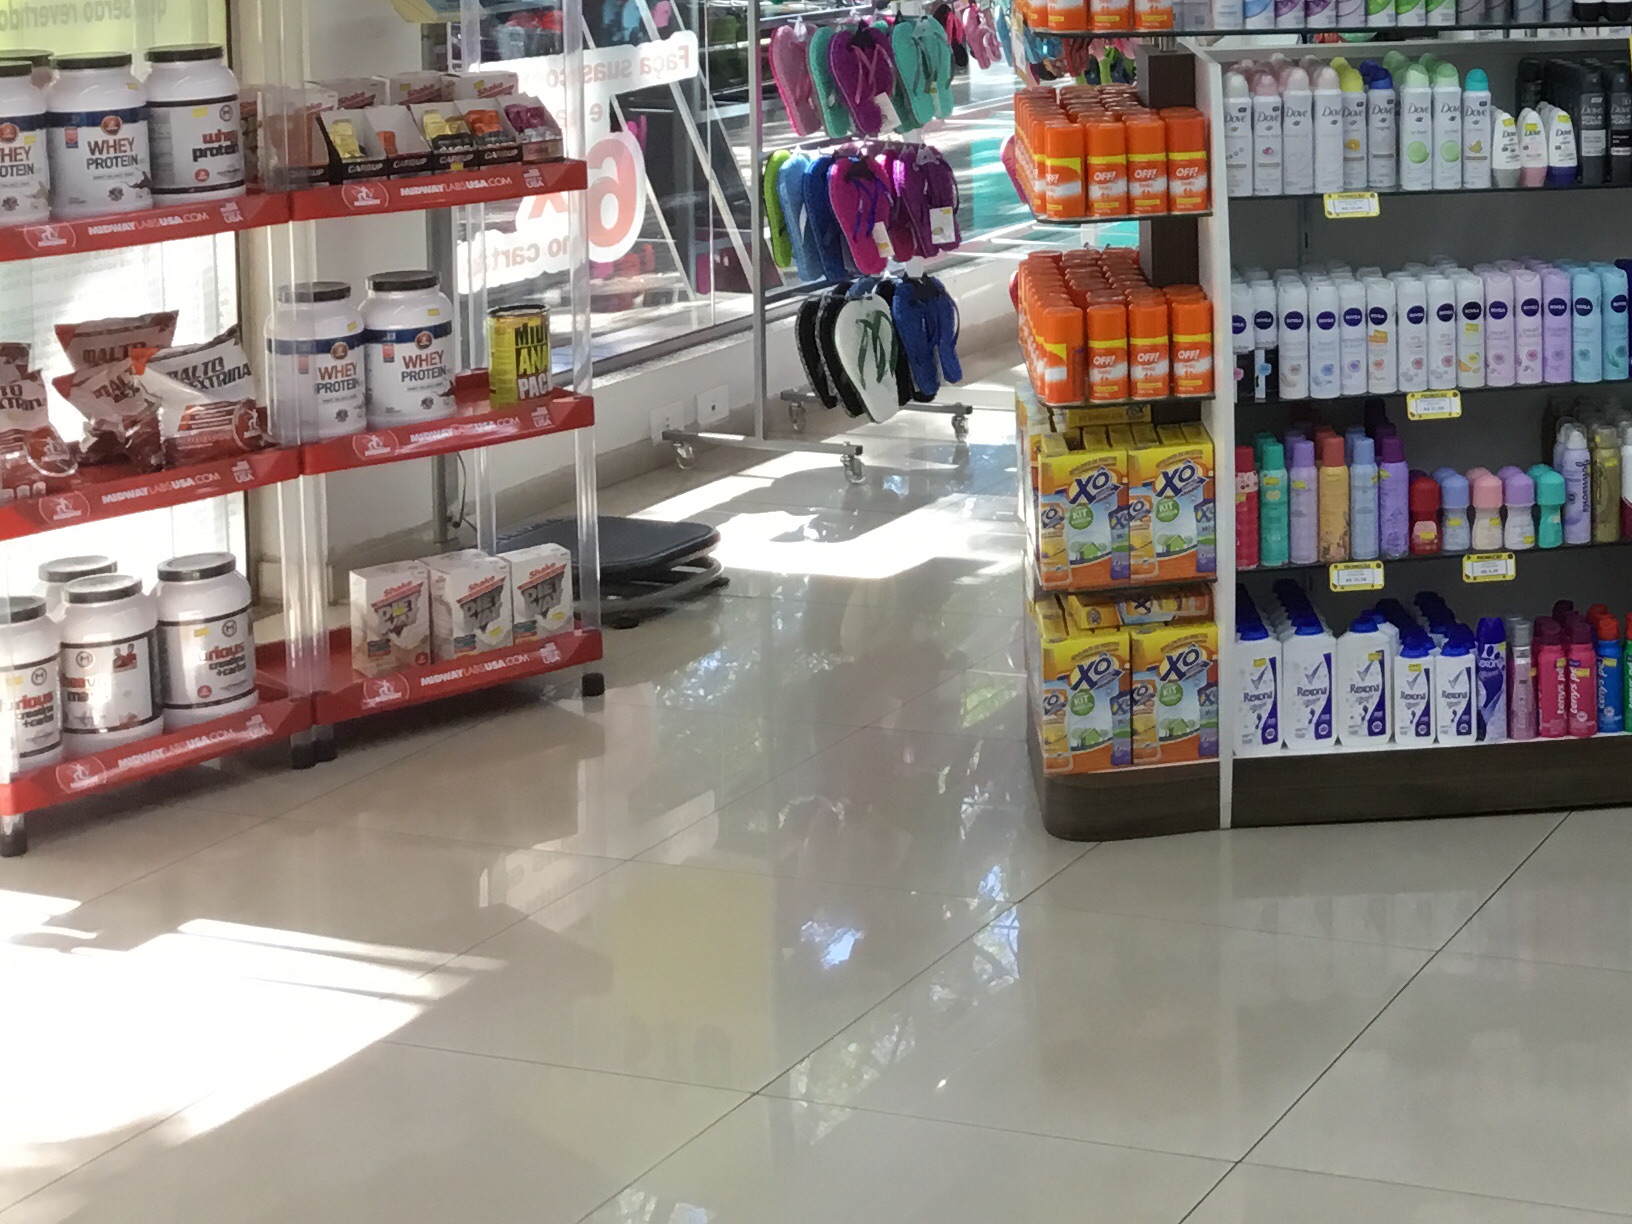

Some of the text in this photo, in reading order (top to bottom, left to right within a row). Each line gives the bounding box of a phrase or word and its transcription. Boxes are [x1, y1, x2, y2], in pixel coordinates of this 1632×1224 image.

[87, 137, 136, 156] WHEY
[86, 154, 139, 171] PROTEIN
[401, 350, 446, 369] WHEY
[318, 362, 358, 380] WHEY
[401, 365, 448, 383] PROTEIN
